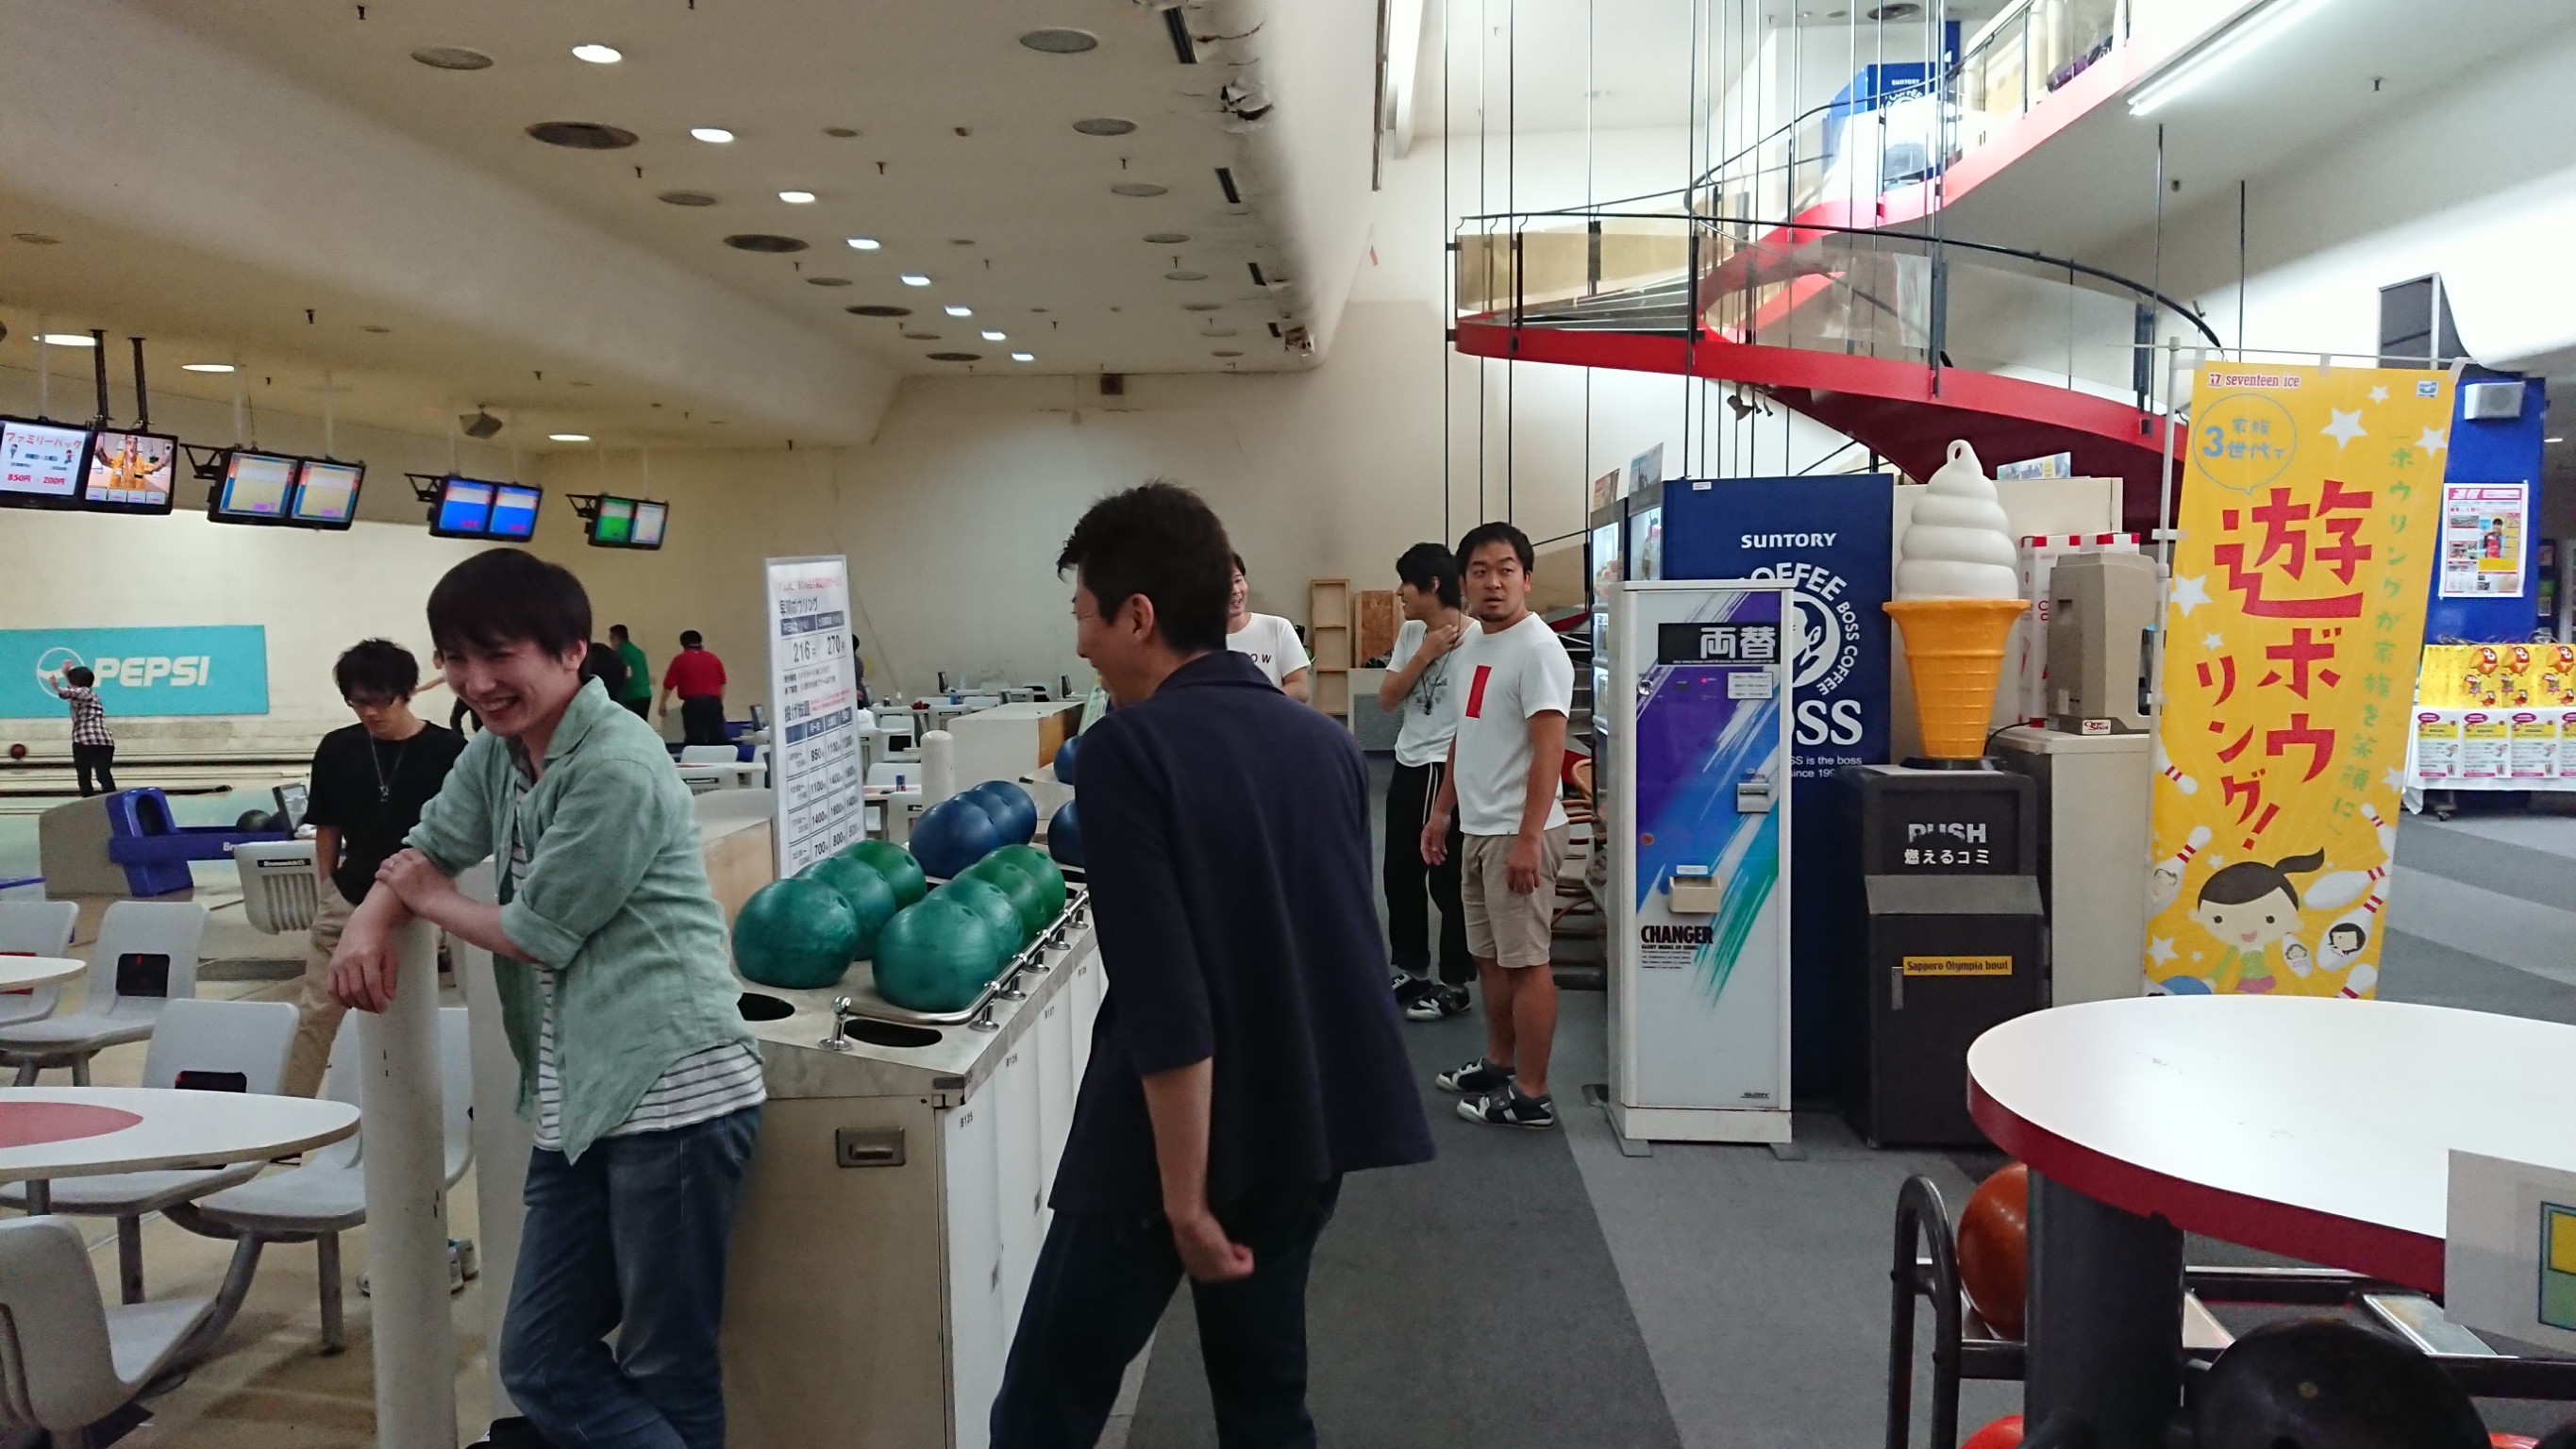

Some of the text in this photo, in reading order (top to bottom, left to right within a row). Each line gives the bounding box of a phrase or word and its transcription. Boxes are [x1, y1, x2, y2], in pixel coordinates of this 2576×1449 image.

[2225, 375, 2280, 386] seventeen
[2283, 374, 2300, 387] ice
[1740, 533, 1838, 549] SUNTORY
[1738, 562, 1848, 602] OFFEE
[1700, 625, 1777, 659] 両替
[1815, 601, 1860, 696] BOSS COFFEE
[93, 656, 210, 688] PEPSI
[1792, 699, 1864, 745] SS
[1806, 757, 1815, 765] is
[1818, 757, 1834, 765] the
[1837, 757, 1863, 765] boss
[1641, 925, 1715, 944] CHANGER
[1907, 960, 2009, 973] Sapporo Olympia bowl
